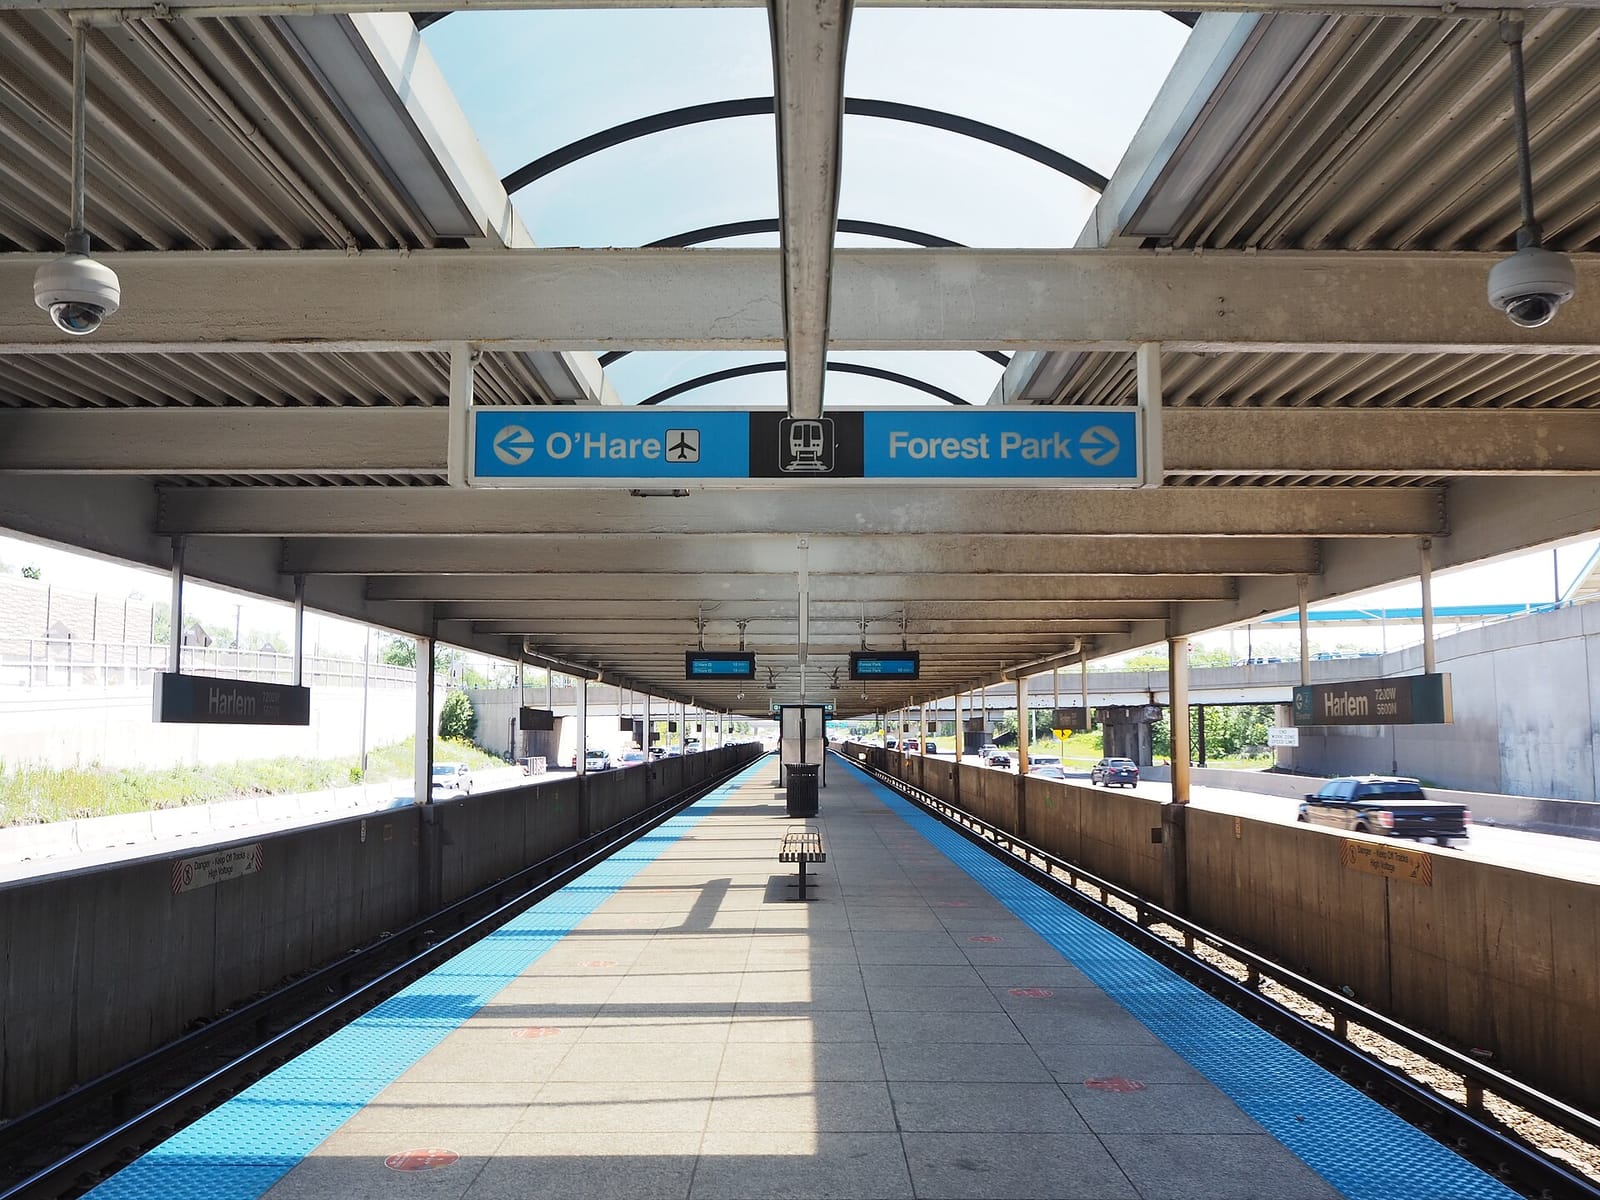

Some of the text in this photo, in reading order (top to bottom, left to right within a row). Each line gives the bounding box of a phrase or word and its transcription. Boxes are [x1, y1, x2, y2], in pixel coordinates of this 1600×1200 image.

[546, 431, 661, 460] O'Hare
[889, 431, 1072, 460] Forest Park
[208, 687, 256, 716] Harlem
[1324, 691, 1369, 717] Harlem
[194, 861, 210, 871] Danger
